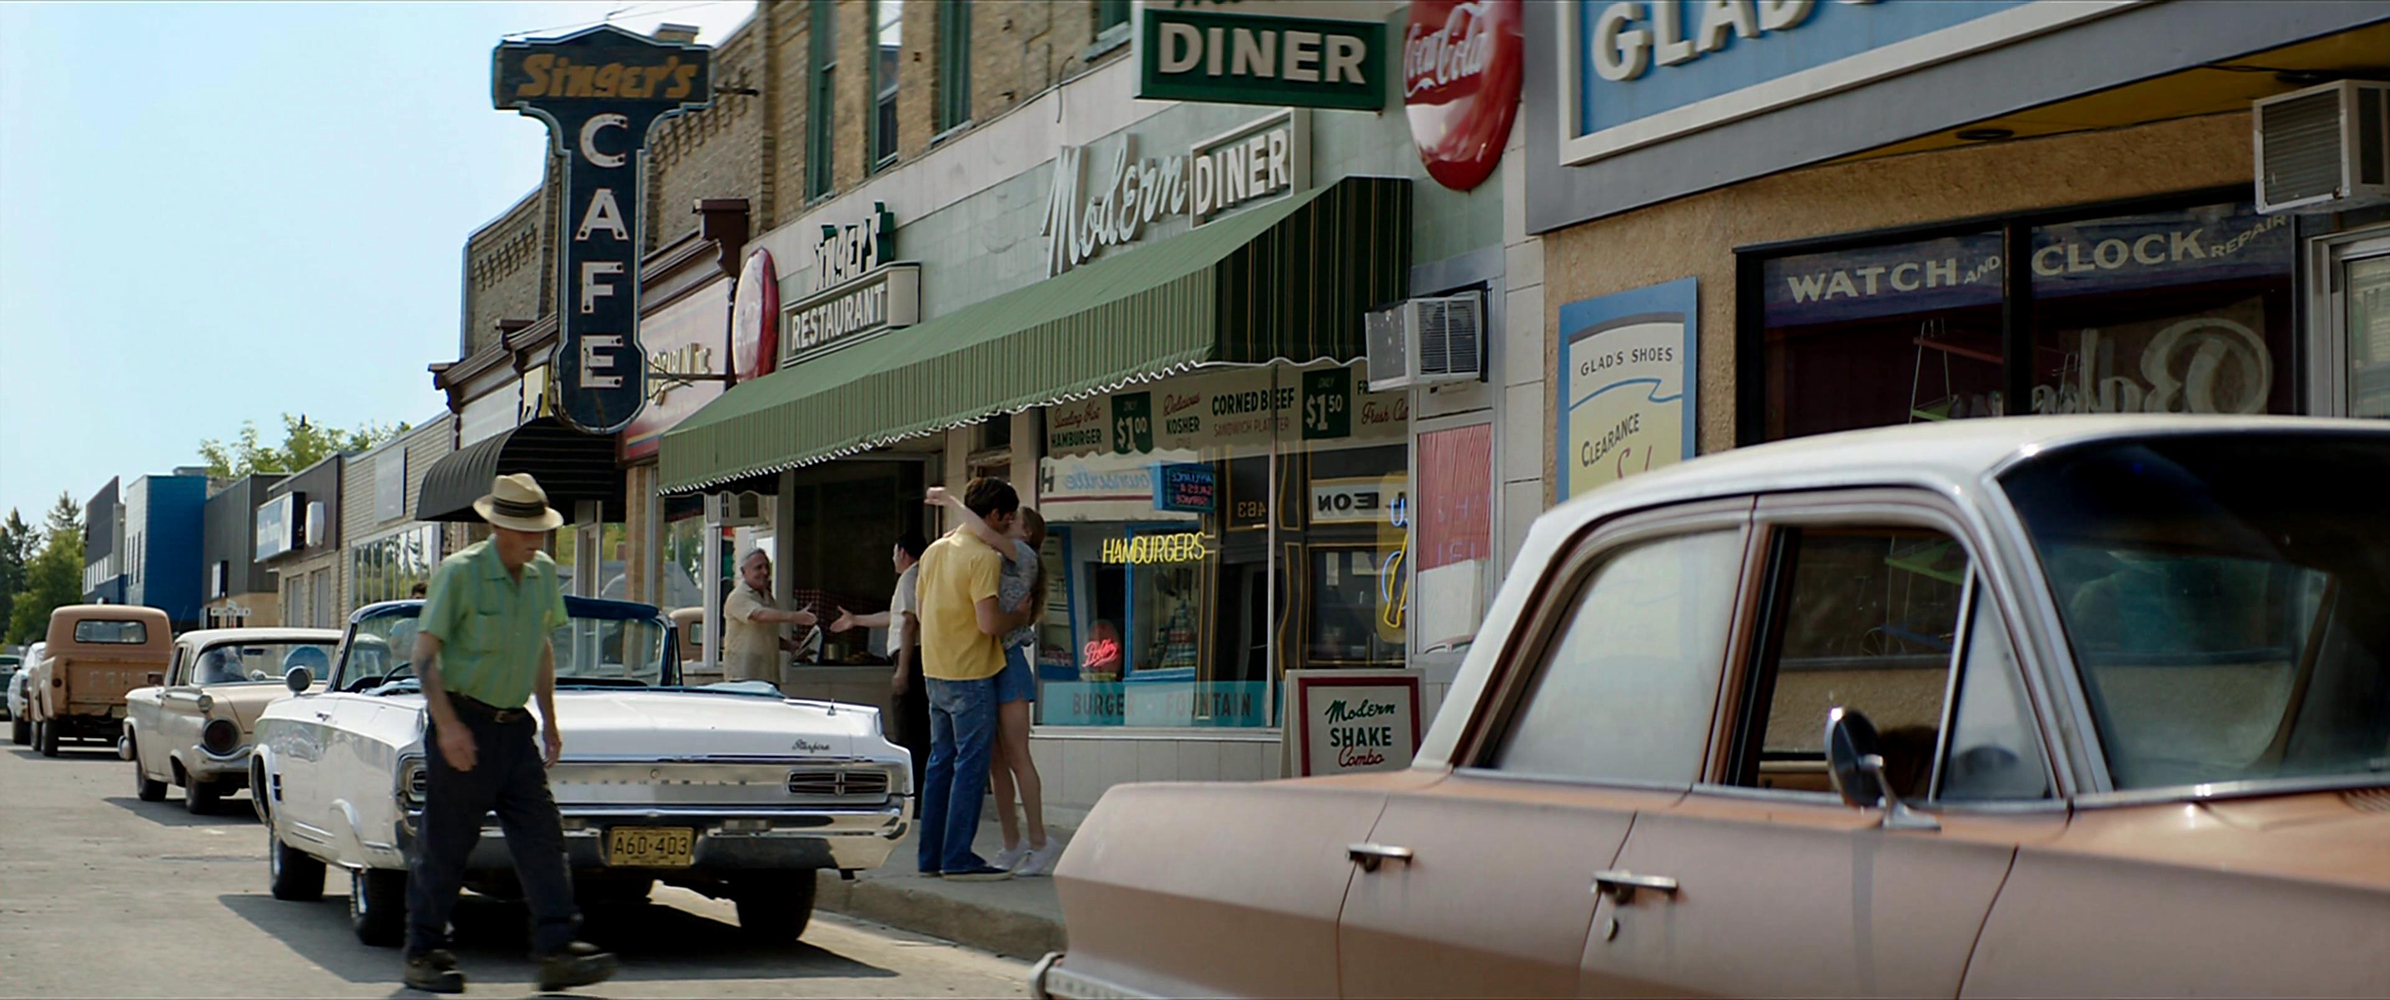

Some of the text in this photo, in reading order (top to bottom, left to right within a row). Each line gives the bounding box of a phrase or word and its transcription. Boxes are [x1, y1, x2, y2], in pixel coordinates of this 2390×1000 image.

[1159, 22, 1367, 84] DINER
[517, 53, 698, 98] Singer's
[1039, 128, 1290, 279] Modern DINER
[574, 113, 629, 389] CAFE
[1787, 215, 2287, 303] WATCH AND CLOCK REPAIR
[792, 282, 887, 350] RESTAURANT
[1580, 347, 1673, 377] GLAD'S SHOES
[1212, 387, 1295, 416] CORNED BEEF
[1051, 429, 1102, 448] HAMBURGER
[1166, 416, 1200, 435] KOSHER
[1102, 531, 1206, 565] HAMBURGERS
[1073, 692, 1252, 717] BURGER FOUNTAIN
[1324, 698, 1396, 725] Modern
[1330, 726, 1393, 747] SHAKE
[1338, 744, 1386, 768] Combo
